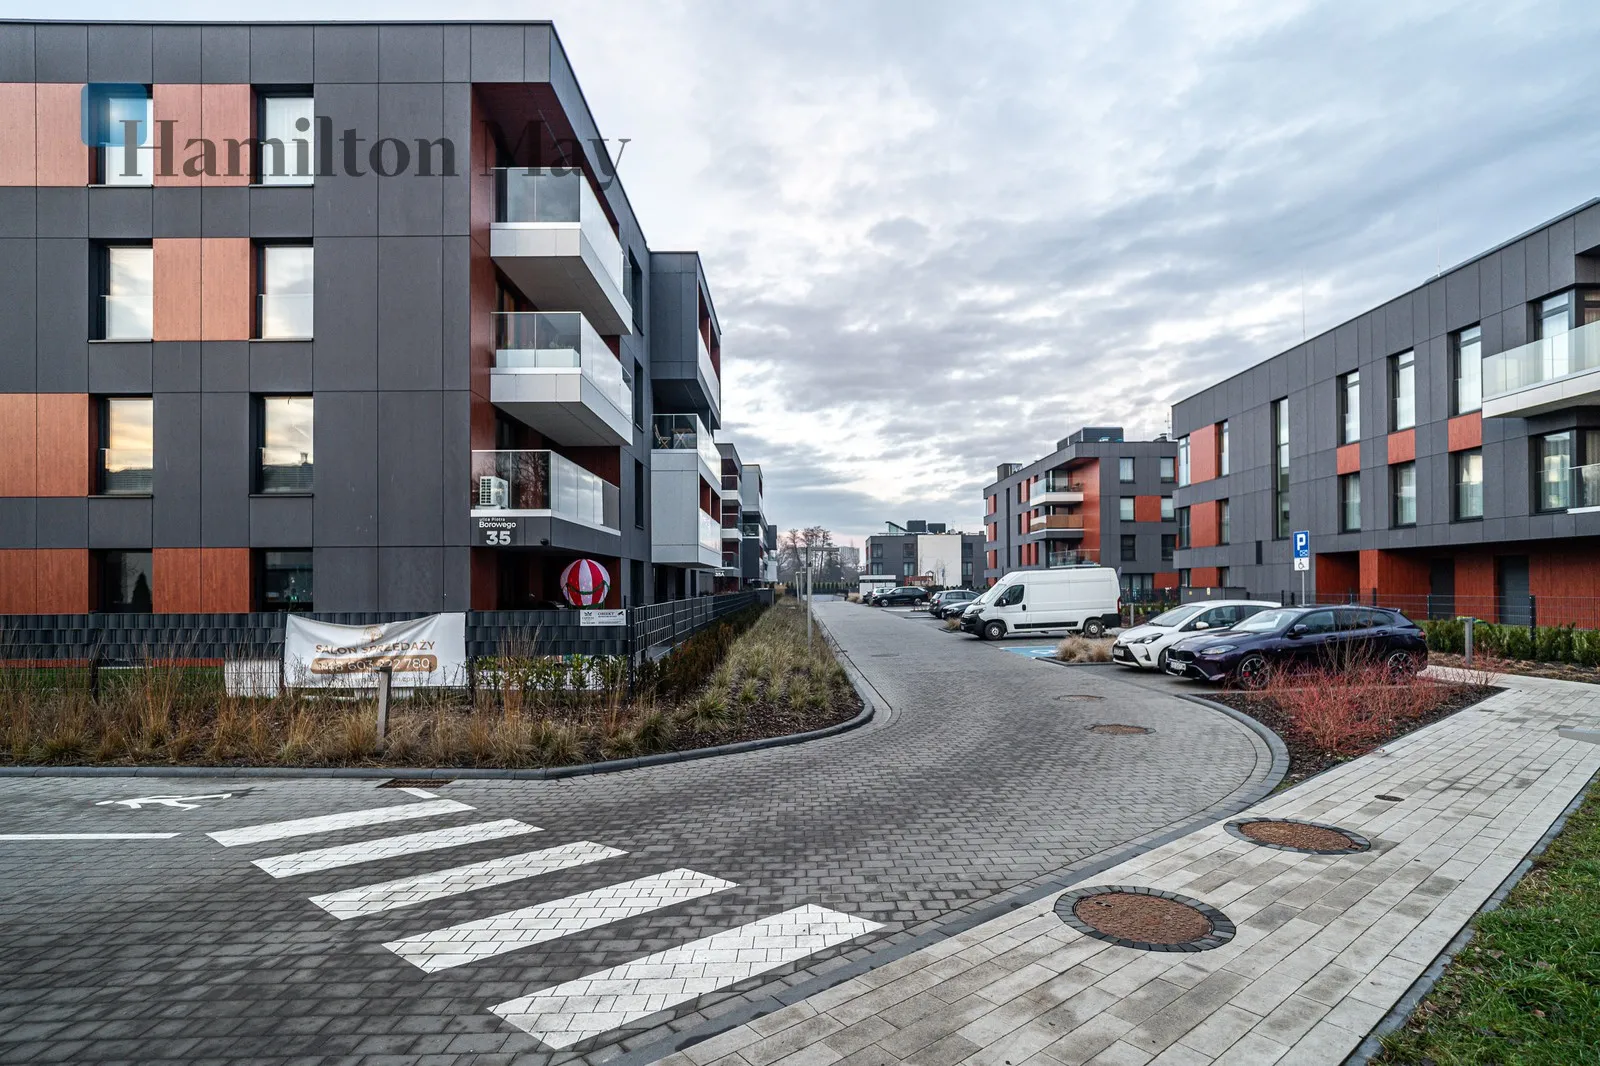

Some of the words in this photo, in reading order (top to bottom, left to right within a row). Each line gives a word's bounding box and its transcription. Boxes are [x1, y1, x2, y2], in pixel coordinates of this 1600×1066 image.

[478, 521, 517, 529] Borowego
[485, 530, 511, 546] 35
[1296, 533, 1306, 551] P
[315, 644, 358, 655] SALON
[361, 640, 436, 654] SPRZEDAŻY
[347, 659, 374, 671] 603
[404, 657, 430, 669] 780
